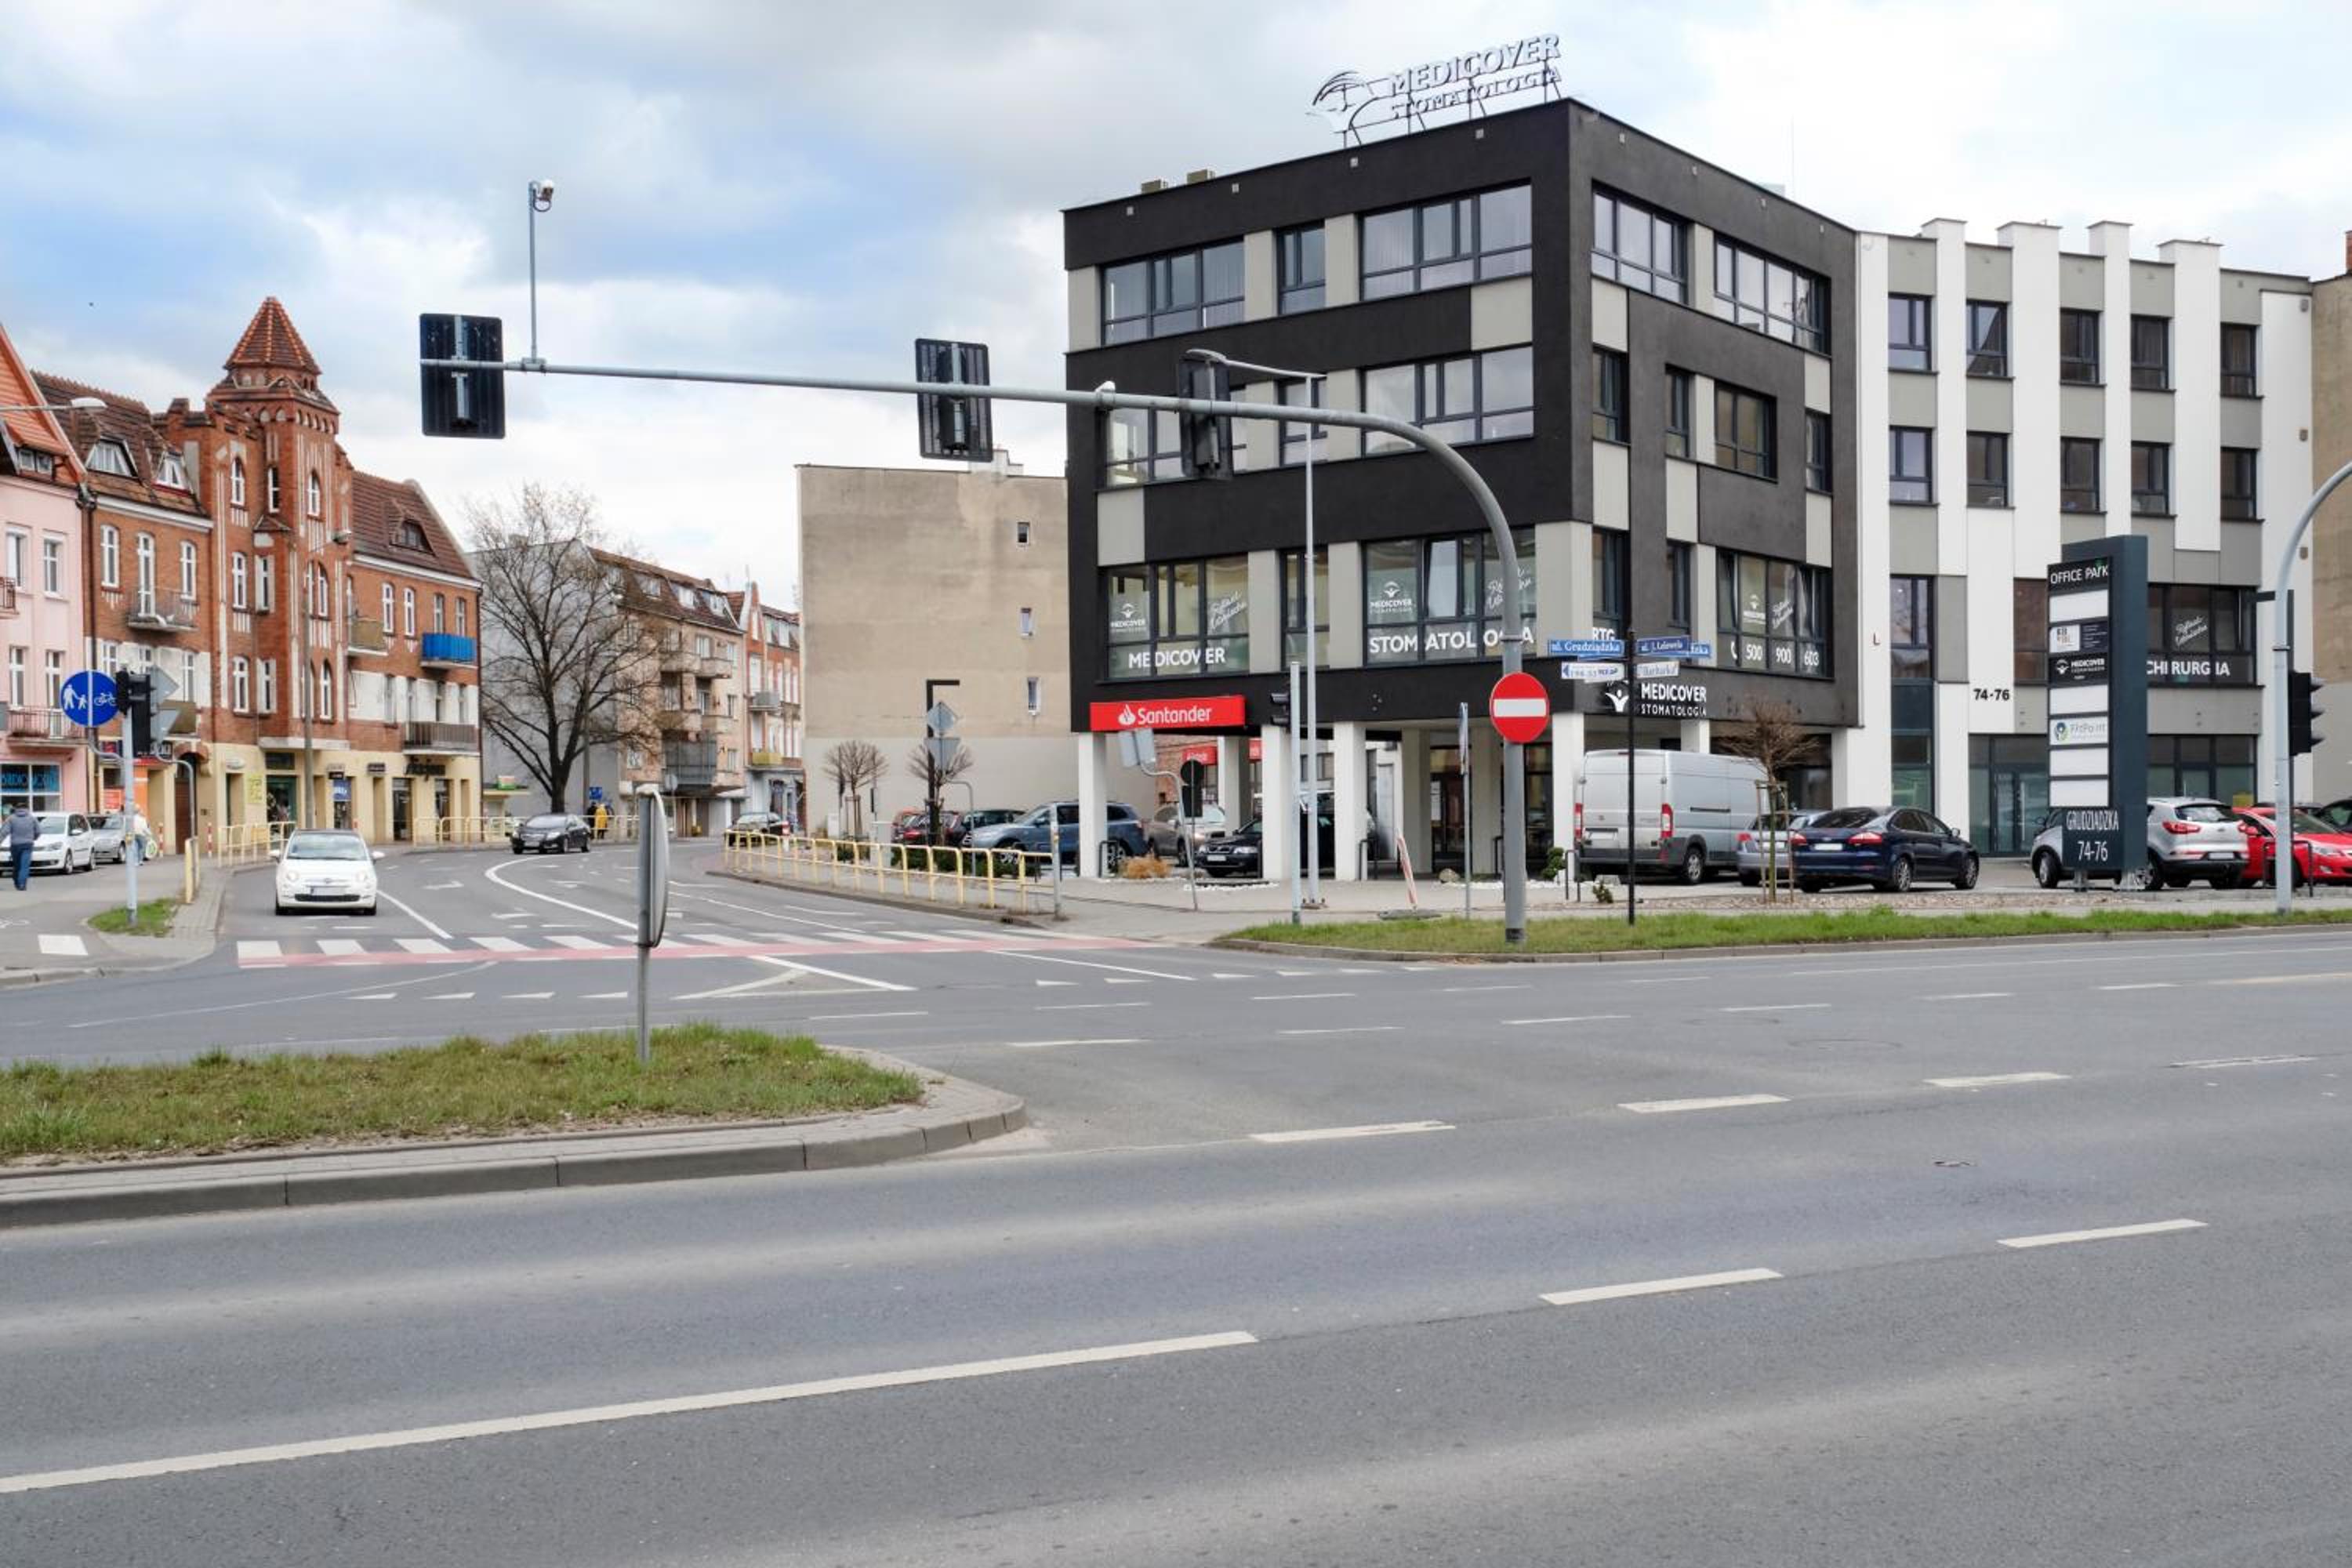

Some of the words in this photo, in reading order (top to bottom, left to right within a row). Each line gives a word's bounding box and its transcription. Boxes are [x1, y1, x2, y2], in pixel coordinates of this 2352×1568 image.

[1389, 34, 1561, 95] MEDICOVER
[2050, 568, 2083, 583] OFFICE
[1370, 626, 1534, 653] STOMATOLOA
[1129, 648, 1225, 668] MEDICOVER
[1746, 644, 1763, 661] 500
[1776, 647, 1791, 664] 900
[1804, 651, 1820, 666] 603
[1641, 682, 1707, 702] MEDICOVER
[1973, 688, 2010, 701] 74-76
[1138, 706, 1213, 725] Santander
[1641, 703, 1707, 717] STOMATOLOGIA
[2078, 840, 2108, 862] 74-76
